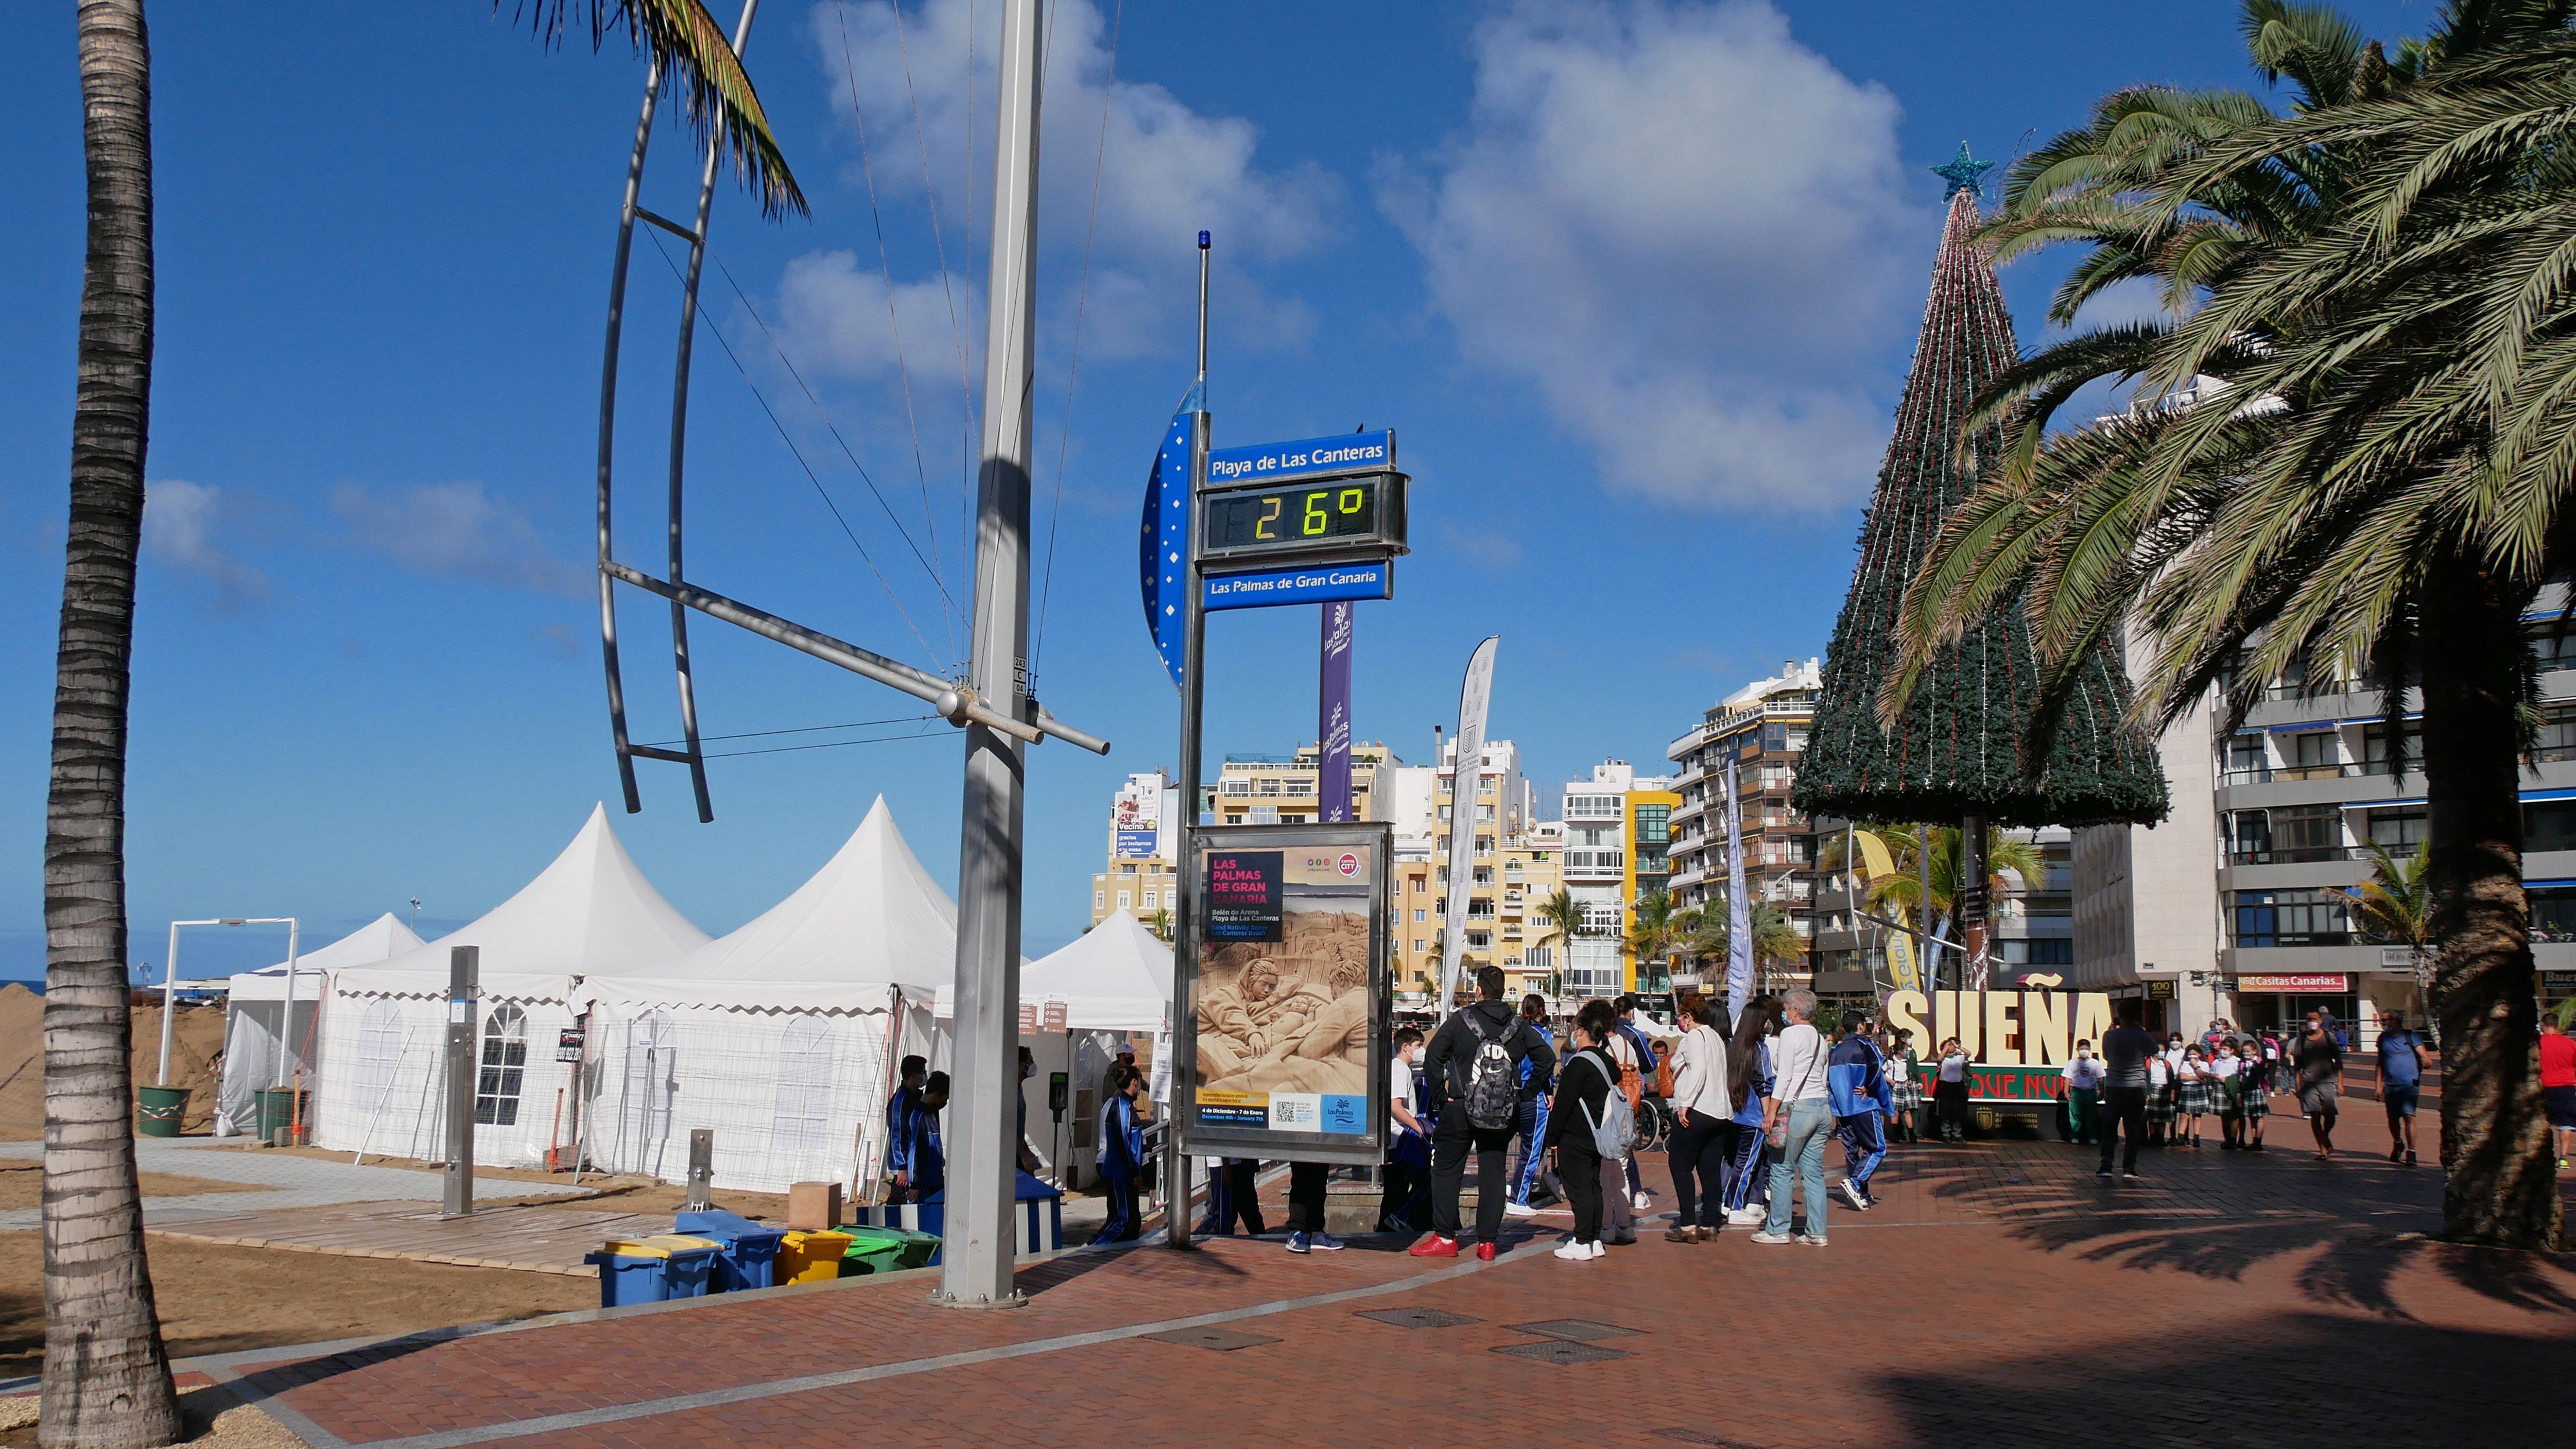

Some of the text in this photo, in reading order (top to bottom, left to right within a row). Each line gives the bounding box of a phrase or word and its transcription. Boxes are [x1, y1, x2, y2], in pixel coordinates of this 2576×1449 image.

[1212, 445, 1383, 478] Playa de Las Canteras
[1211, 571, 1376, 594] Las Palmas de Gran Canaria
[1015, 658, 1026, 668] 243
[1018, 671, 1022, 680] C
[1016, 684, 1023, 692] 04
[1213, 860, 1236, 869] LAS
[1213, 871, 1262, 880] PALMAS
[1213, 882, 1266, 892] DE GRAN
[1212, 894, 1267, 905] CANARIA
[1212, 916, 1229, 924] Playa
[2255, 976, 2336, 985] Casitas Canarias
[2152, 982, 2170, 991] 100
[1887, 973, 2113, 1067] SUEÑA
[1968, 1072, 2018, 1098] QUE
